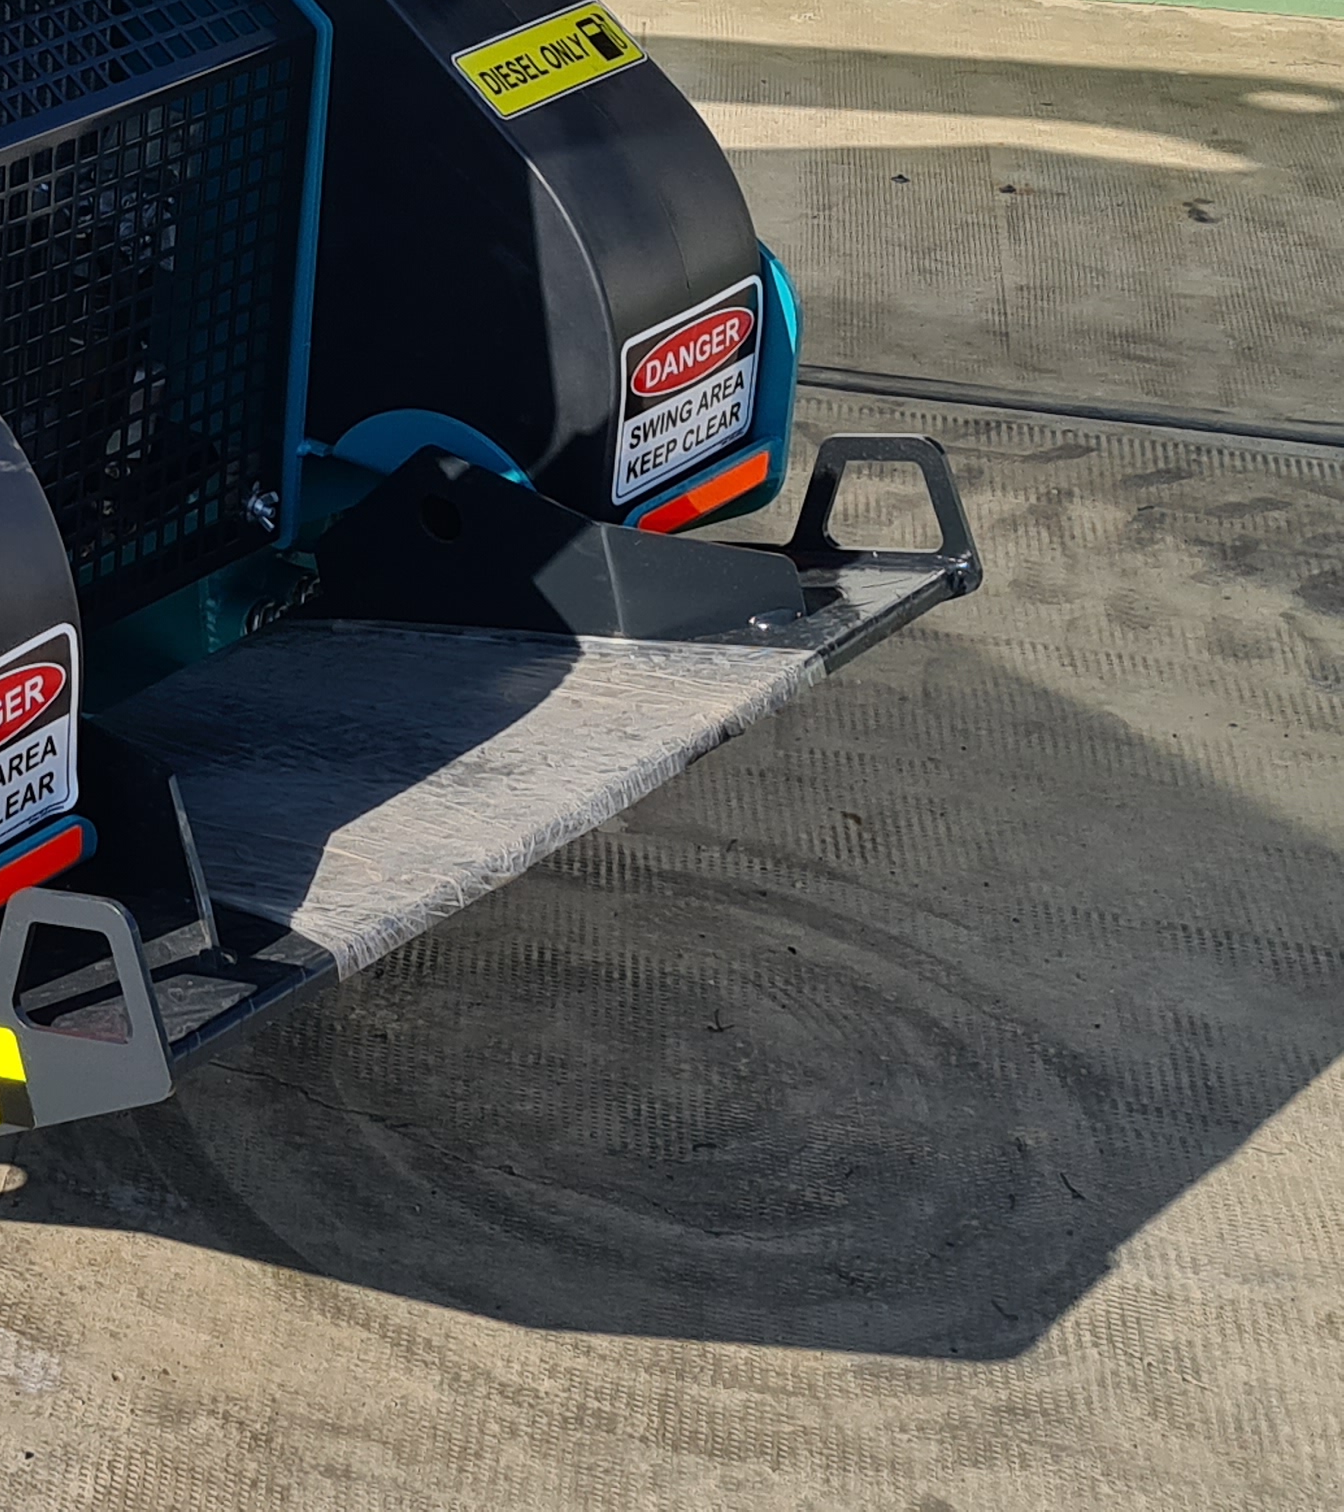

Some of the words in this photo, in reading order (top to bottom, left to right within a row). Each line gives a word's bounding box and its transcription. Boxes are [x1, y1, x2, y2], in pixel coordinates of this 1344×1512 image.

[478, 53, 550, 96] DIESEL
[539, 33, 590, 69] ONLY
[645, 317, 740, 389] DANGER
[626, 438, 677, 484] KEEP
[682, 401, 742, 452] CLEAR
[629, 399, 693, 450] SWING
[696, 370, 744, 416] AREA
